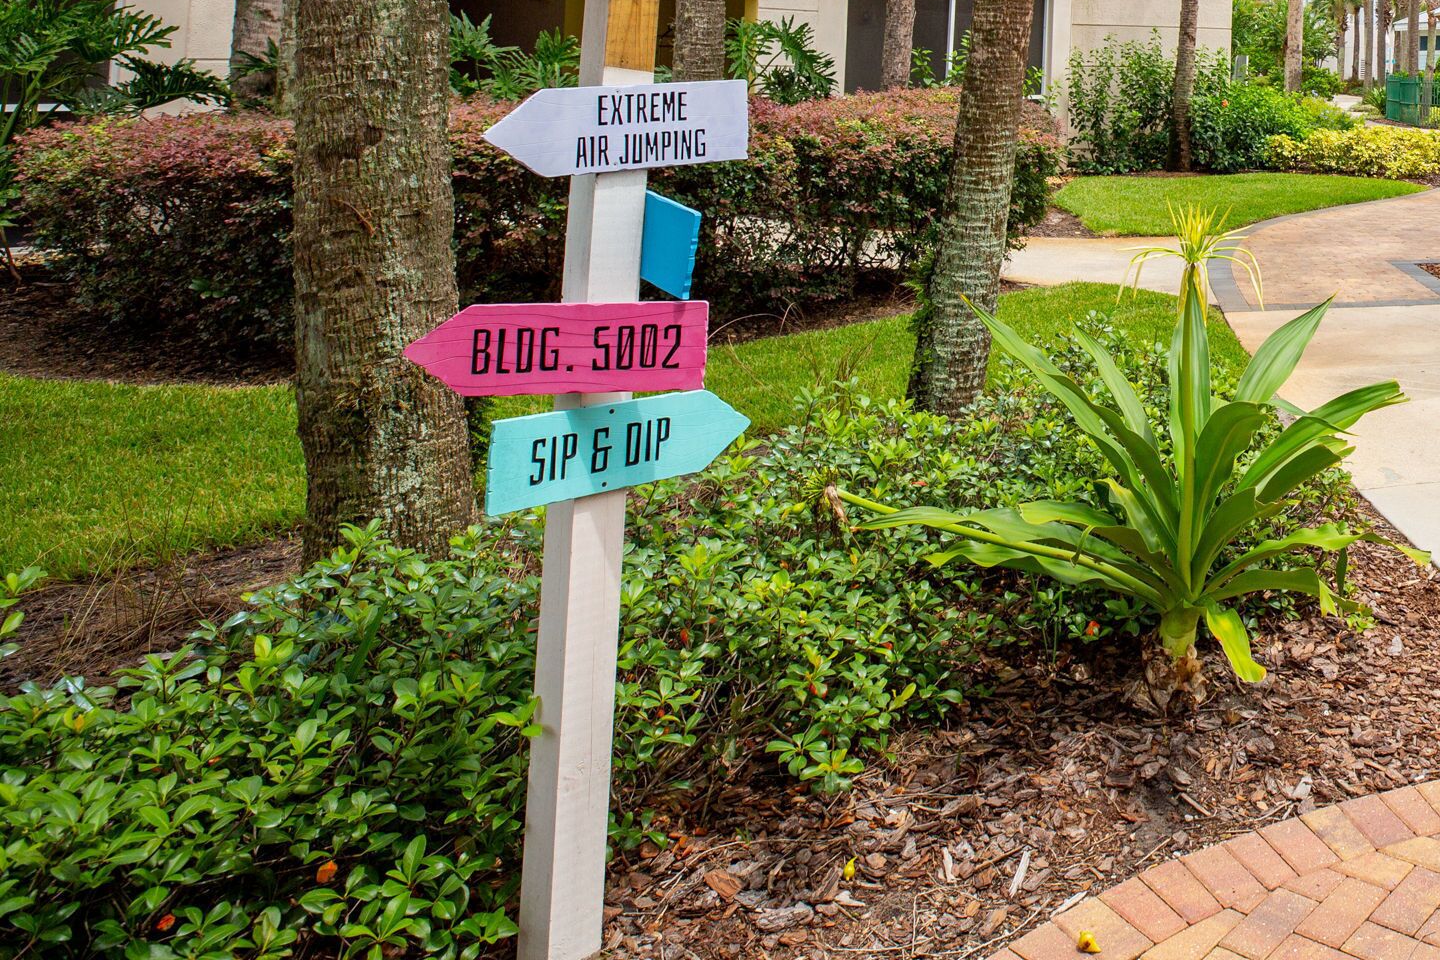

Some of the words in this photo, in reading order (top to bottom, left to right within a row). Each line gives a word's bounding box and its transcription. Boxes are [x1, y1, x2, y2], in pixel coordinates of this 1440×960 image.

[598, 92, 688, 126] EXTREME
[576, 135, 609, 168] AIR
[619, 129, 706, 164] JUMPING
[471, 327, 574, 375] BLDG.
[592, 324, 682, 371] 5002
[530, 433, 578, 486] SIP
[591, 427, 612, 474] &
[625, 417, 671, 467] DIP
